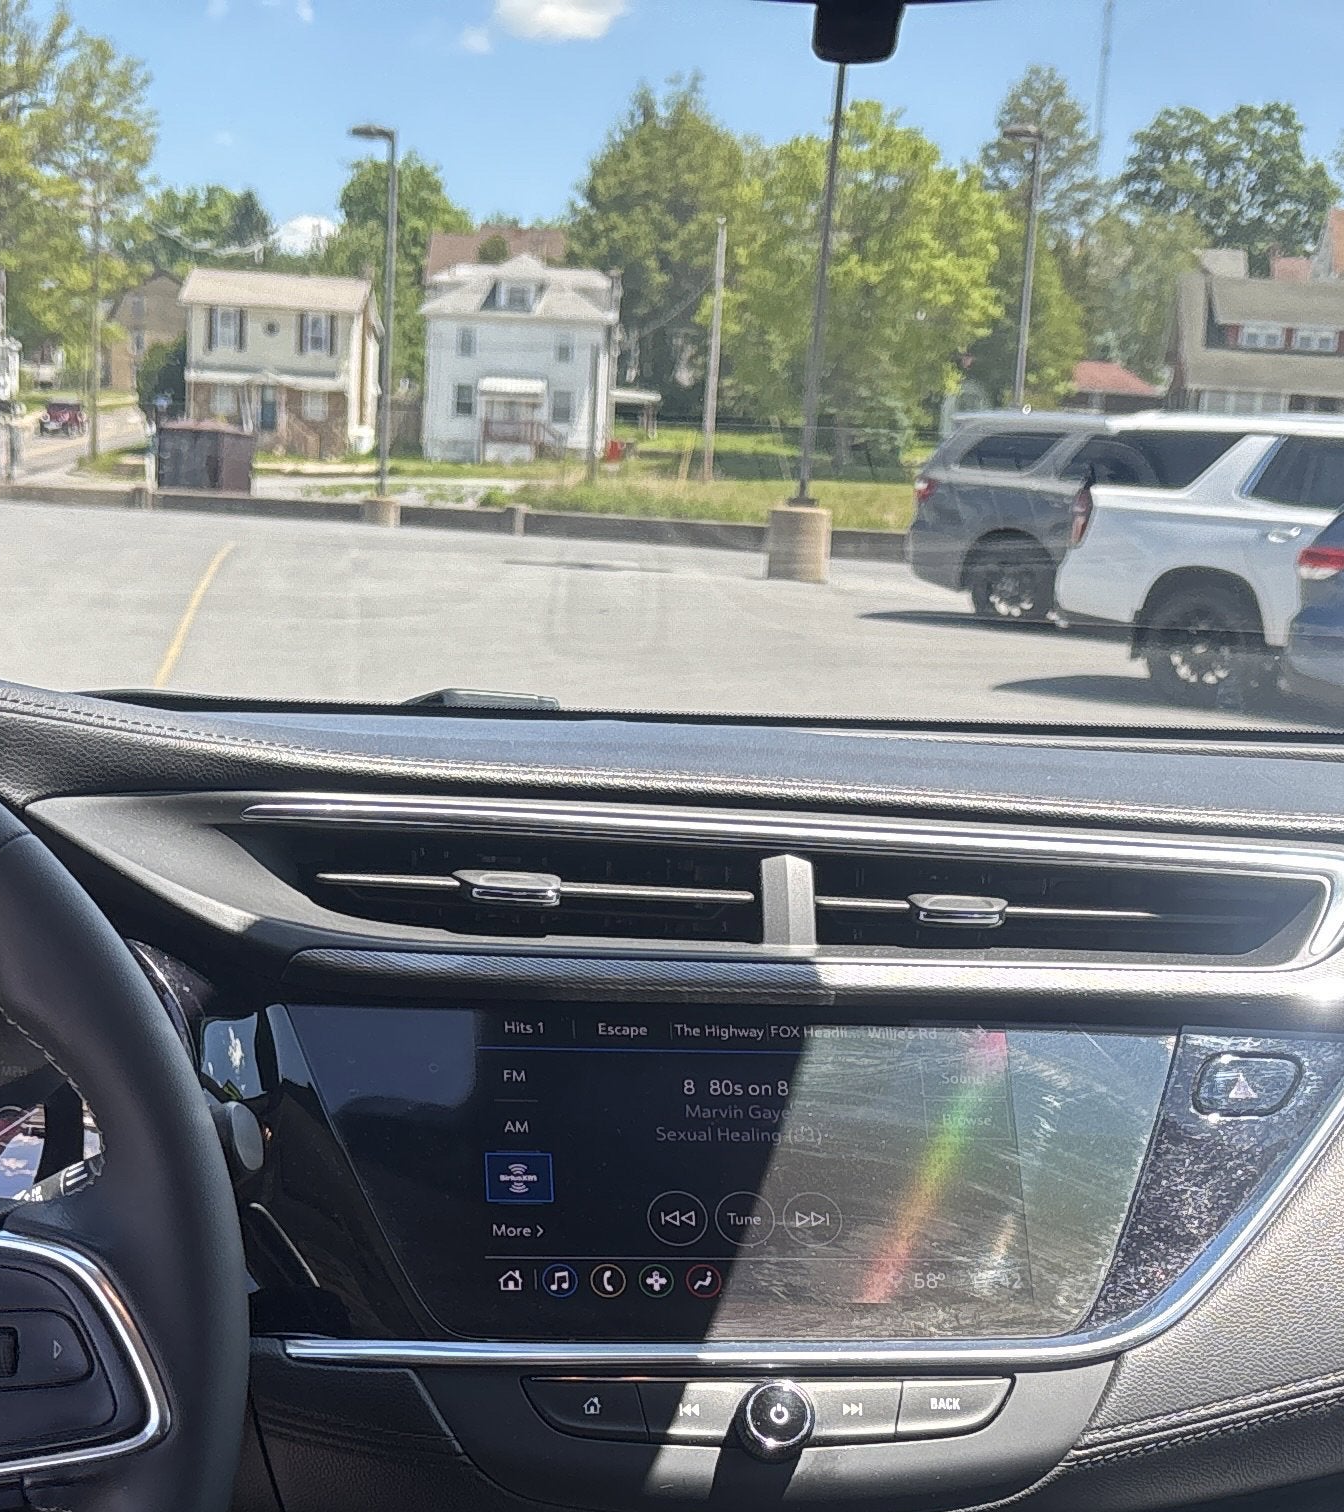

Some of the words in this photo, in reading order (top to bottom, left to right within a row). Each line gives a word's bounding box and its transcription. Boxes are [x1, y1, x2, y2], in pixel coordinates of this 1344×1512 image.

[504, 1022, 533, 1034] Hits
[538, 1023, 544, 1034] 1
[598, 1023, 648, 1038] Escape
[674, 1024, 700, 1037] The
[705, 1025, 764, 1040] Highway
[770, 1026, 800, 1038] FOX
[503, 1070, 526, 1082] FM
[683, 1080, 695, 1095] 8
[709, 1080, 743, 1096] 80s
[748, 1084, 771, 1096] on
[777, 1081, 789, 1096] 8
[685, 1104, 743, 1119] Marvin
[749, 1105, 790, 1123] Gaye
[943, 1114, 992, 1126] Browse
[504, 1120, 528, 1133] AM
[656, 1127, 712, 1142] Sexual
[717, 1127, 782, 1145] Healing
[727, 1212, 762, 1226] Tune
[492, 1224, 532, 1237] More
[930, 1397, 960, 1410] BACK
